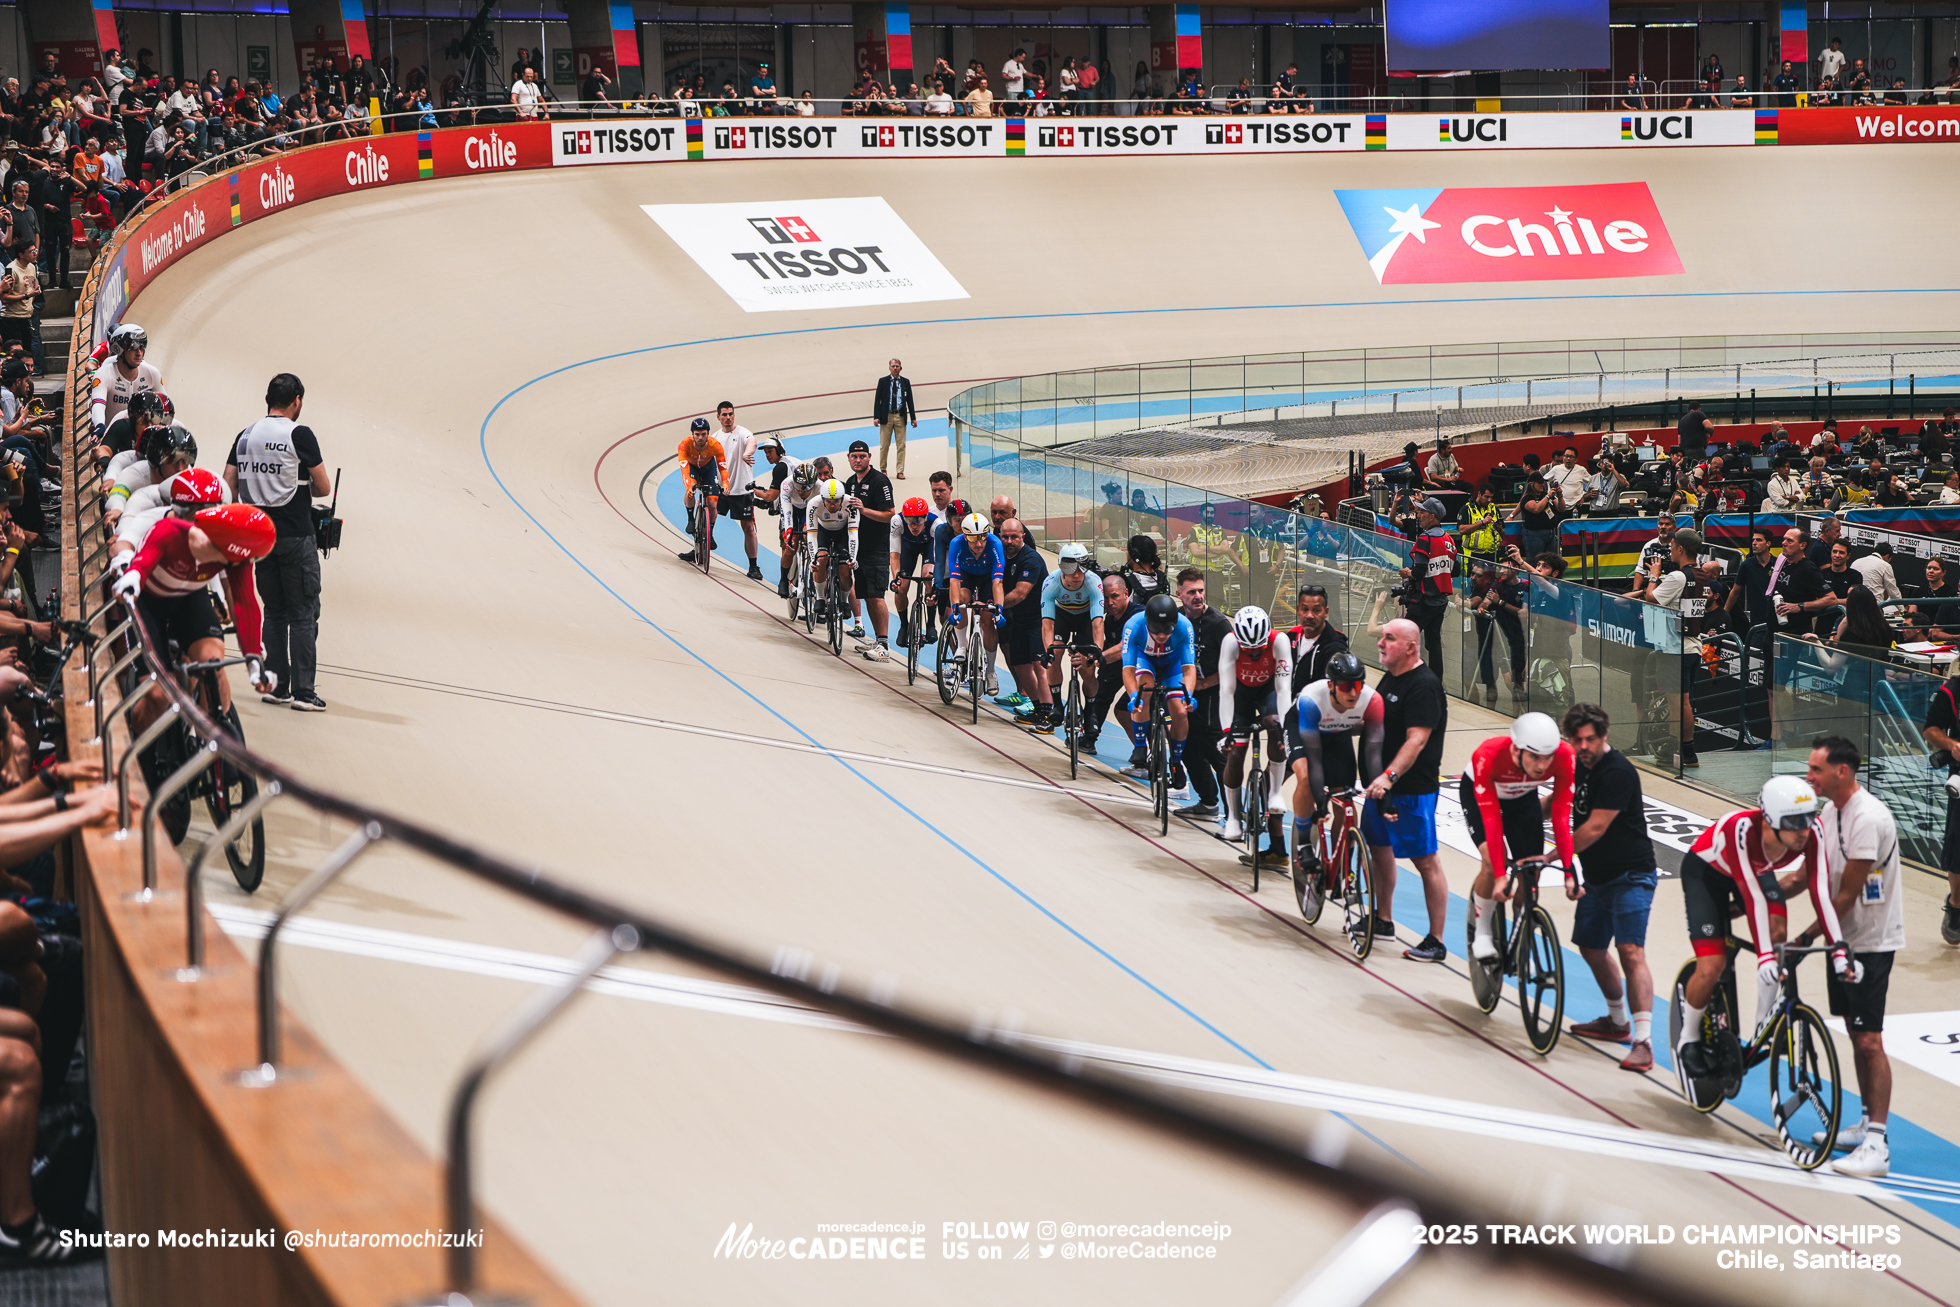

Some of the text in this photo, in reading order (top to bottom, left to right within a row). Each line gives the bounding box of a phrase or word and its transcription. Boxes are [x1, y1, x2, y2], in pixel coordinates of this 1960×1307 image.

[578, 53, 592, 75] D
[857, 47, 868, 69] C
[1152, 47, 1161, 67] B
[749, 126, 837, 149] TISSOT
[898, 125, 993, 147] TISSOT
[1078, 124, 1178, 147] TISSOT
[1247, 122, 1352, 144] TISSOT
[1453, 118, 1507, 142] UCI
[1634, 116, 1692, 140] UCI
[464, 128, 517, 169] Chile
[594, 127, 675, 153] TISSOT
[345, 142, 389, 185] Chile
[259, 161, 295, 209] Chile
[141, 201, 206, 275] Welcome to Chile
[1461, 205, 1650, 257] Chile
[731, 246, 891, 280] TISSOT
[763, 278, 913, 295] SWISS WATCHES SINCE 1853
[113, 394, 129, 405] GBR
[269, 443, 287, 452] UCI
[238, 461, 283, 475] TV HOST
[1864, 531, 1879, 540] TISSOT
[1905, 539, 1920, 547] TISSOT
[228, 543, 251, 557] DEN
[1241, 674, 1270, 683] TTO
